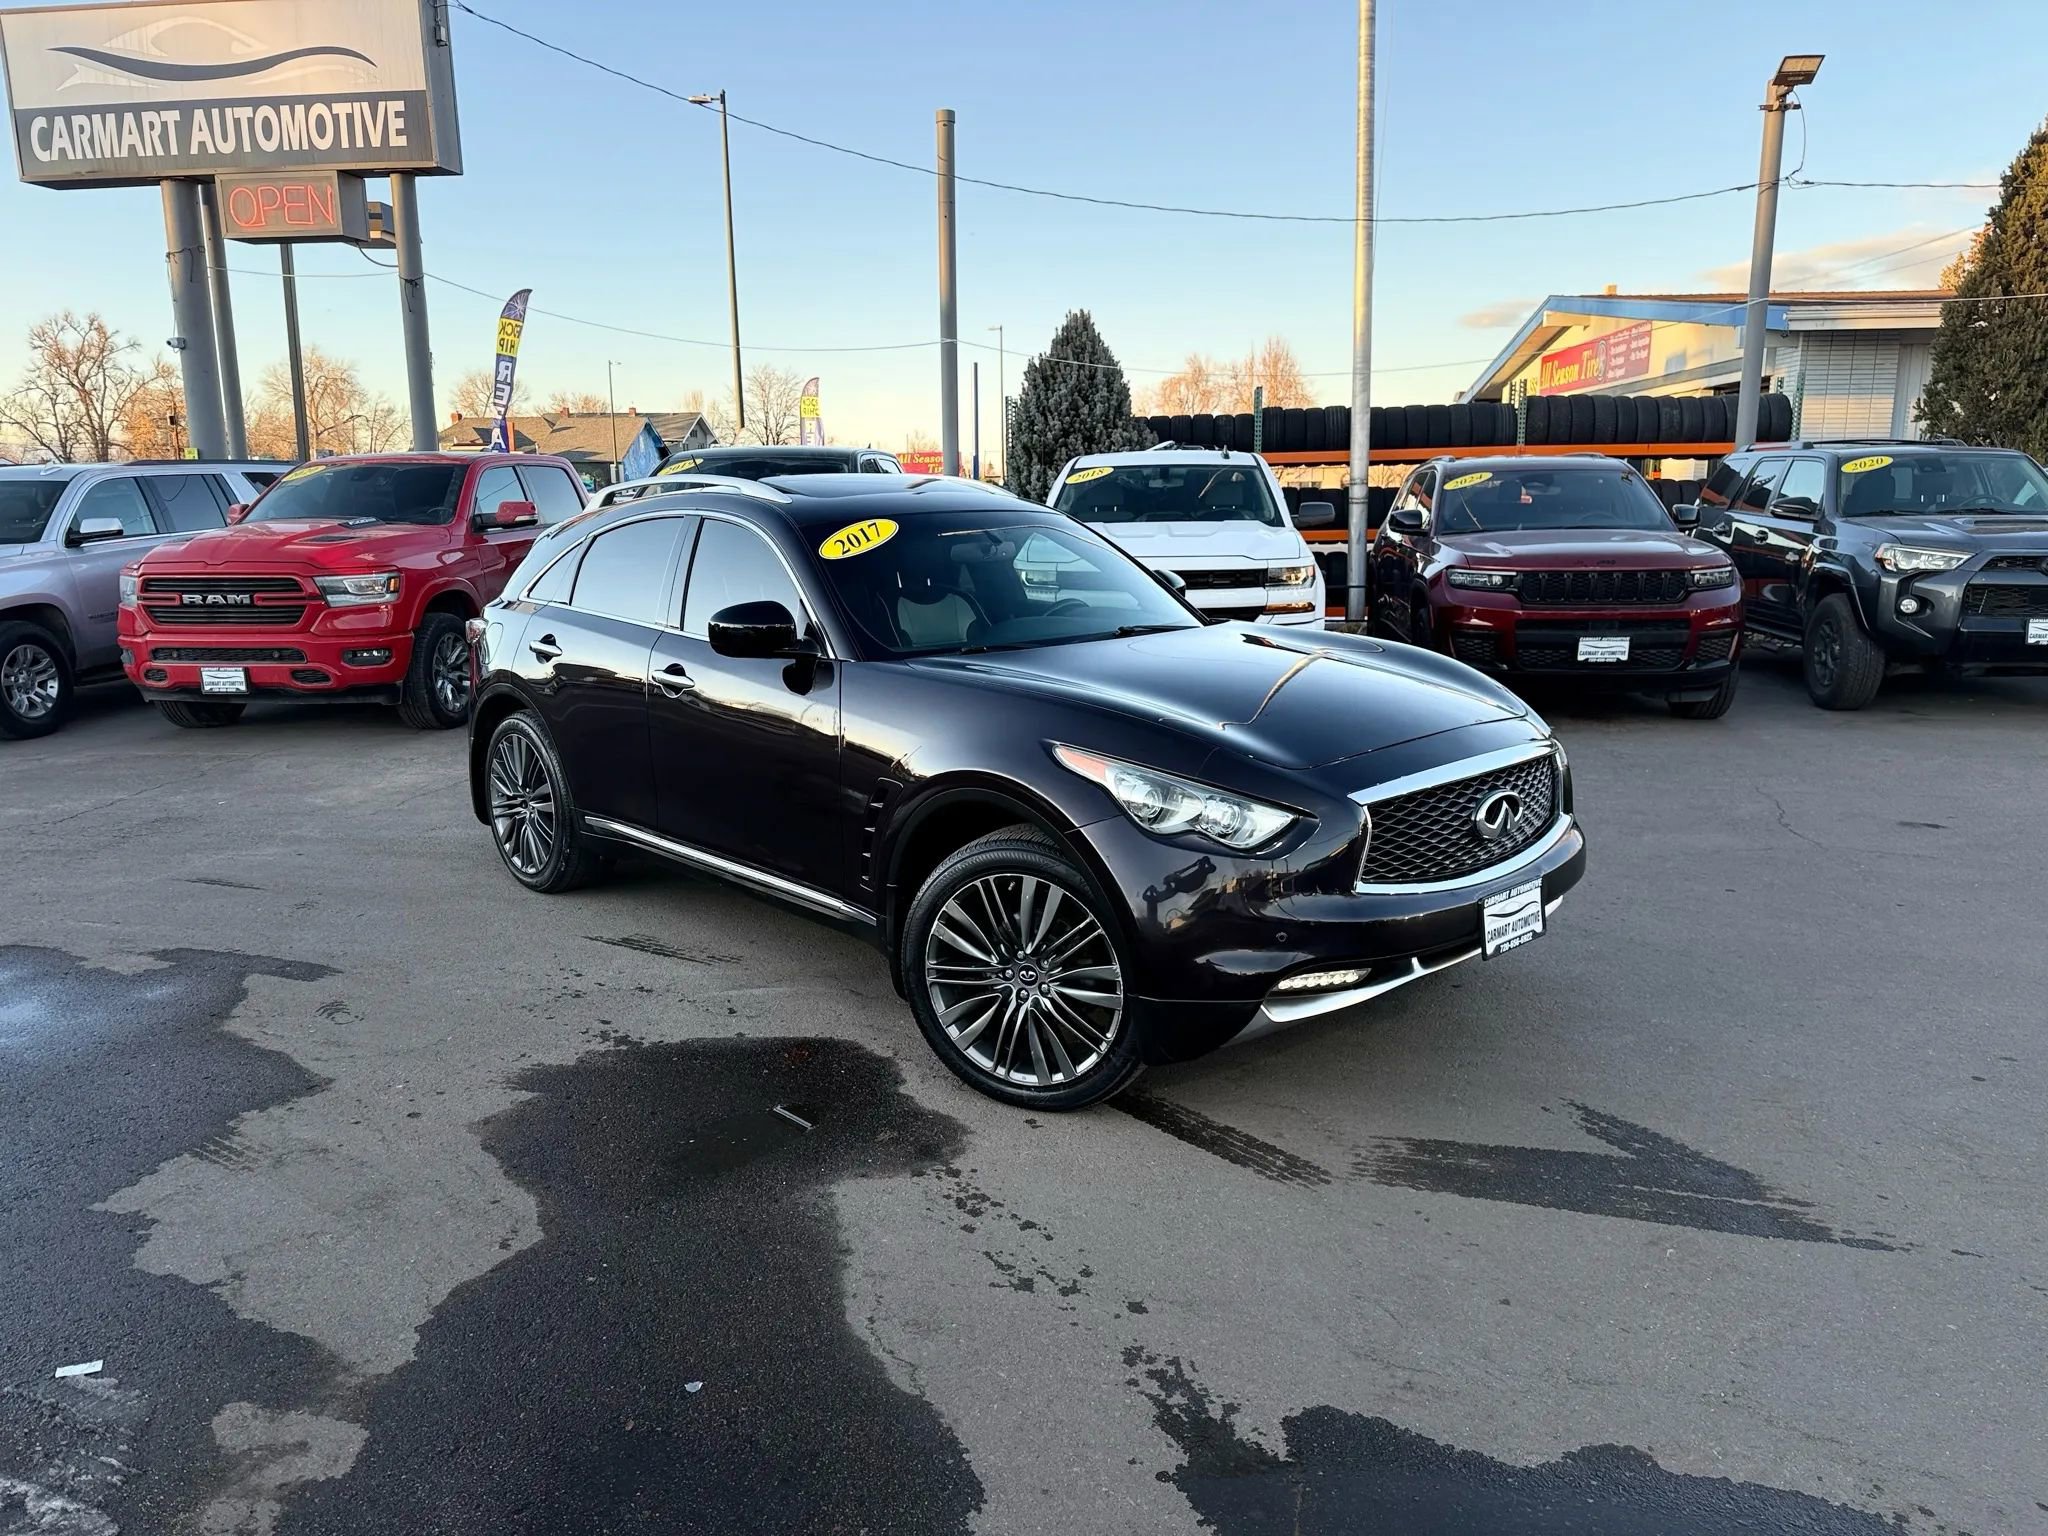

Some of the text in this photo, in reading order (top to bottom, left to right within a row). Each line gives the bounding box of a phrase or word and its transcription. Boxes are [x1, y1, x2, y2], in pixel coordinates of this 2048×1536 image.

[30, 100, 409, 162] CARMART AUTOMOTIVE
[229, 183, 335, 227] OPEN
[1552, 360, 1580, 386] Season
[928, 464, 944, 474] Tir
[1851, 457, 1884, 471] 2020
[833, 522, 881, 556] 2017
[182, 594, 251, 605] RAM
[1484, 877, 1542, 908] CARMART AUTOMOTIVE
[1487, 910, 1540, 944] CARMART AUTOMOTIVE
